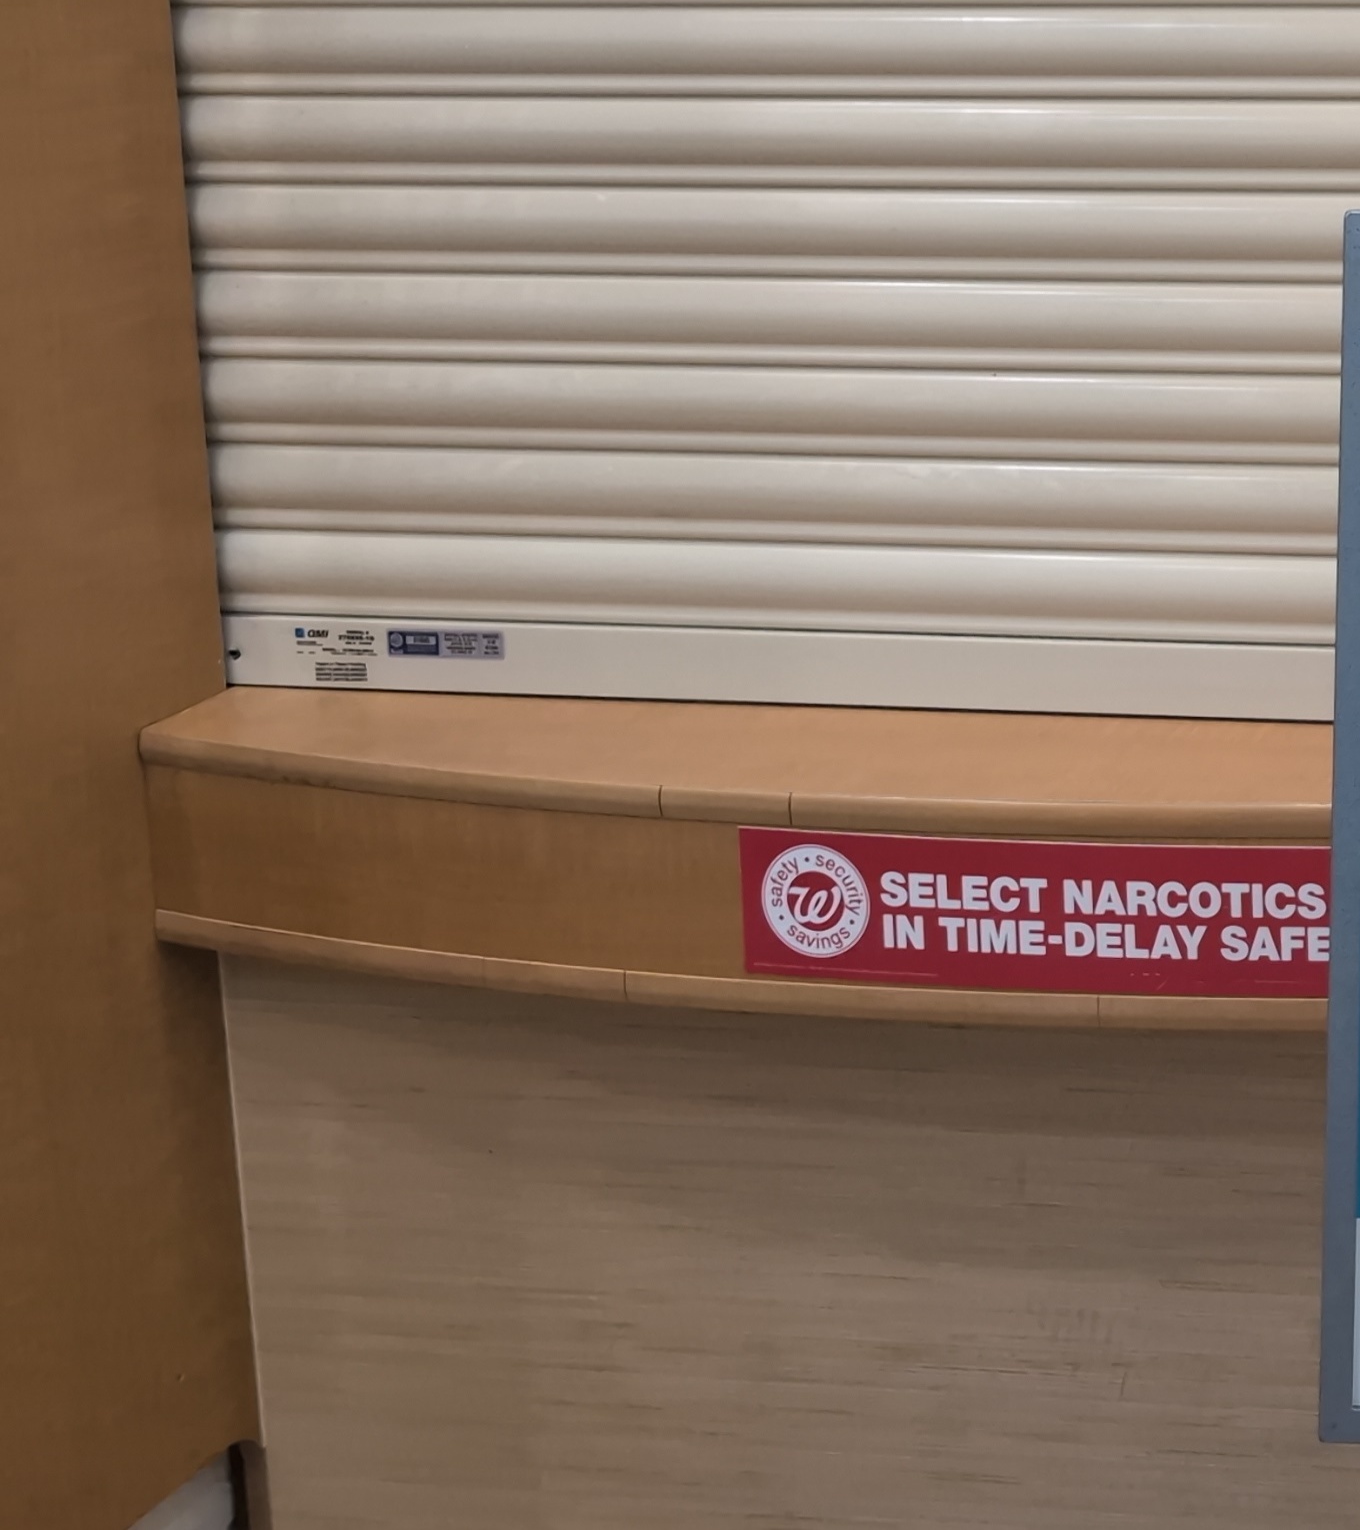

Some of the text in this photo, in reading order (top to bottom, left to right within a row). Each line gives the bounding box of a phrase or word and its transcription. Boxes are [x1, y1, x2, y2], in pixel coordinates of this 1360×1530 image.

[771, 857, 799, 908] safety
[815, 854, 864, 916] security
[880, 871, 1327, 920] SELECT NARCOTICS
[787, 925, 851, 949] savings
[882, 913, 1330, 962] IN TIME-DELAY SAFE
